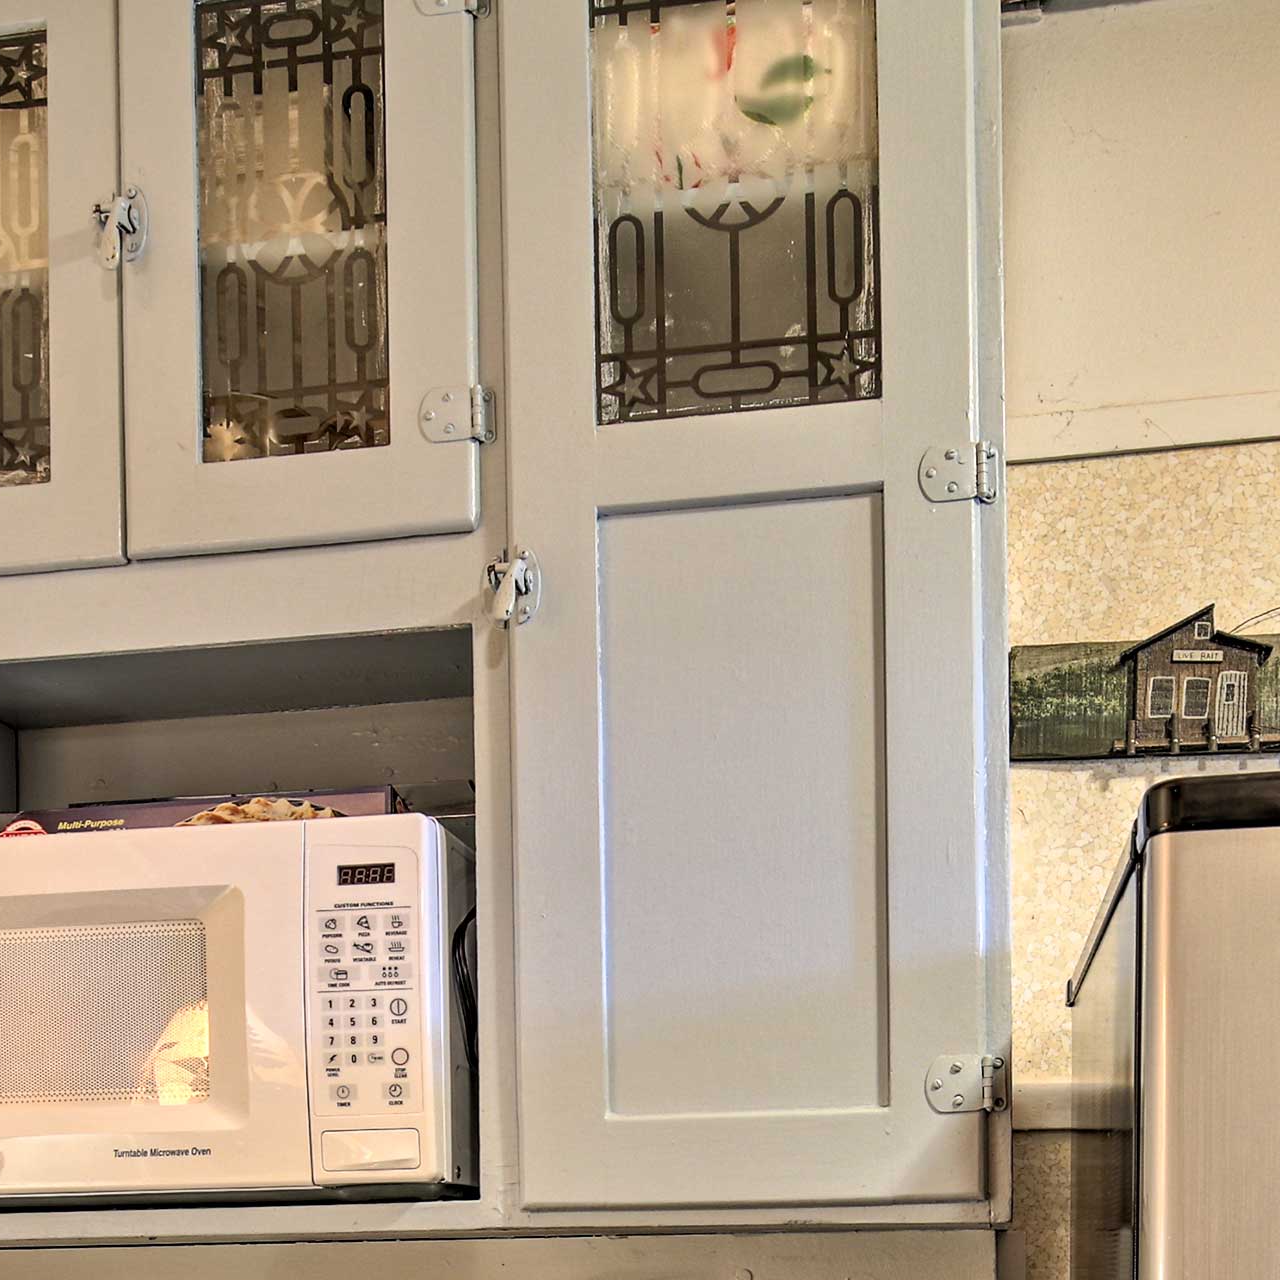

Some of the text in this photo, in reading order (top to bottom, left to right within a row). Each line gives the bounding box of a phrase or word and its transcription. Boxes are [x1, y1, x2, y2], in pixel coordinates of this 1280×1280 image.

[57, 818, 125, 831] Multi-Purpose
[328, 999, 333, 1009] 1
[349, 998, 356, 1008] 2
[371, 998, 377, 1007] 3
[328, 1018, 334, 1027] 4
[350, 1017, 356, 1026] 5
[371, 1016, 378, 1026] 6
[328, 1036, 335, 1045] 7
[350, 1036, 357, 1045] 8
[372, 1035, 378, 1044] 9
[351, 1054, 357, 1063] 0
[113, 1146, 212, 1158] Turntable Microwave Oven
